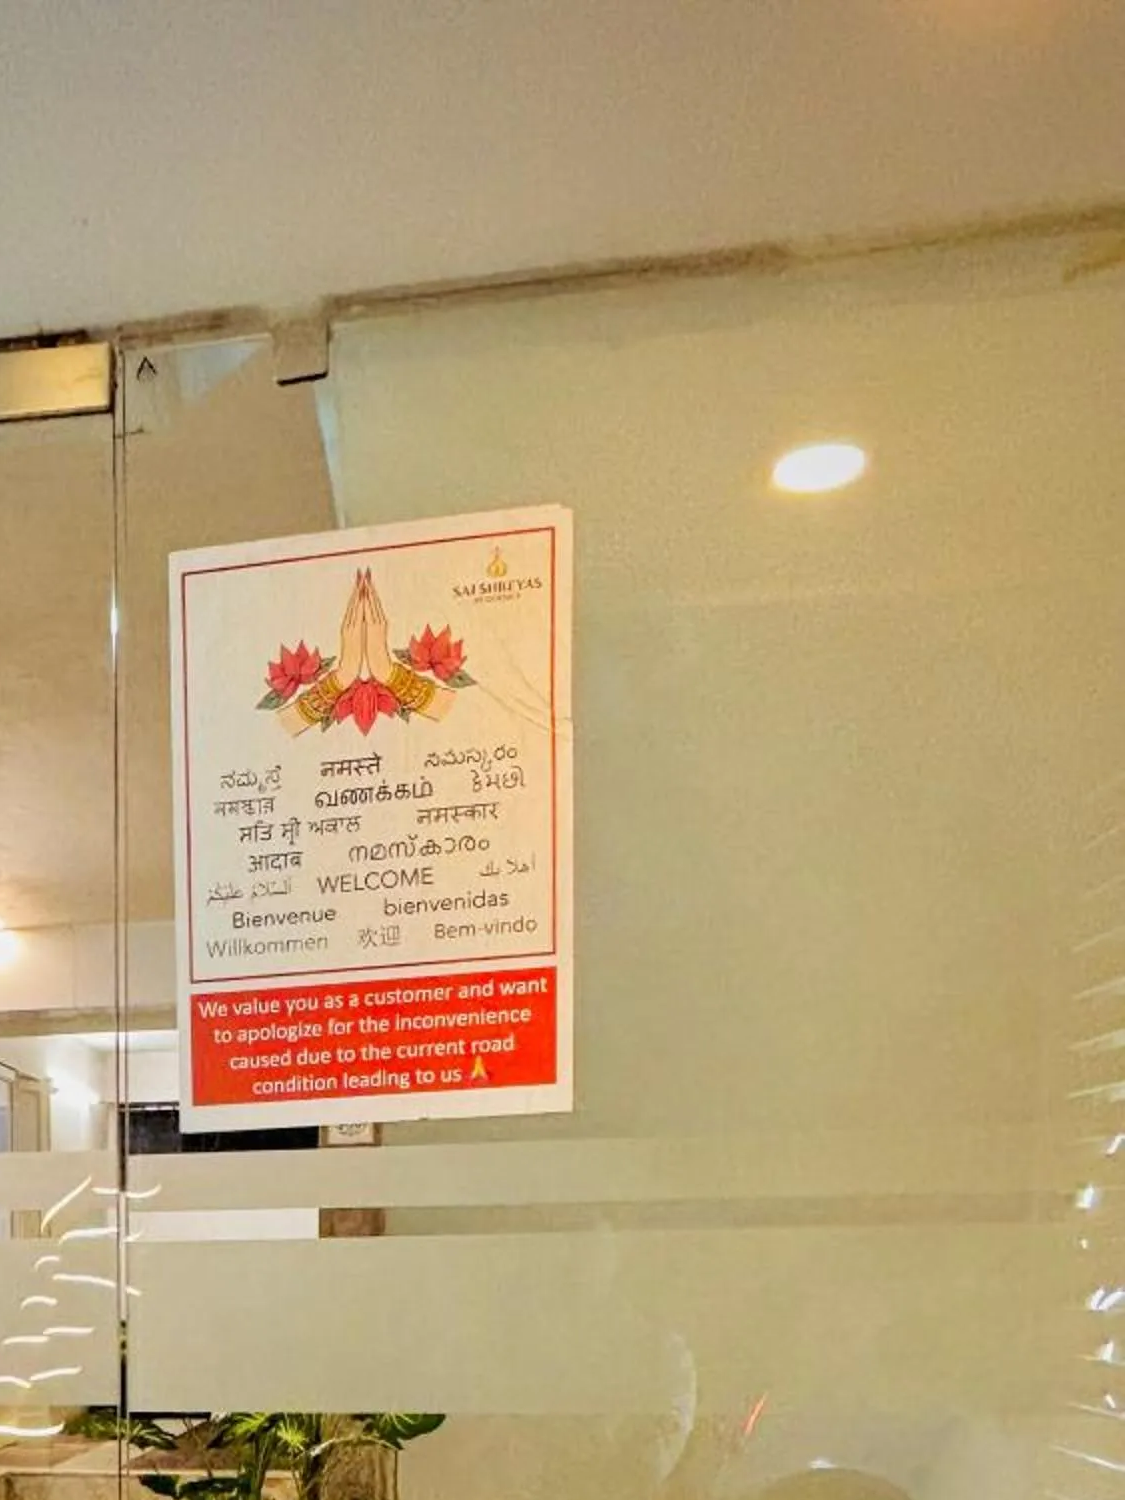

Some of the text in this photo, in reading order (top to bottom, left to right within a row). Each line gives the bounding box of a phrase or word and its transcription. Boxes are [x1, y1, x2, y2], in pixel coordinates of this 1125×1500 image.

[320, 752, 382, 777] नमस्ते
[315, 776, 433, 808] வணக்கம்
[416, 802, 499, 825] नमस्कार
[249, 851, 303, 873] आदाब
[317, 867, 435, 894] WELCOME
[384, 889, 510, 916] bienvenidas
[232, 908, 336, 928] Bienvenue
[434, 916, 538, 939] Bem-vindo
[206, 936, 328, 958] Willkommen
[357, 925, 401, 949] 欢迎
[199, 977, 548, 1019] We value you as a customer and want
[214, 1007, 532, 1046] to apologize for the inconvenience
[230, 1032, 515, 1070] caused due to the current road
[252, 1067, 462, 1095] condition leading to us
